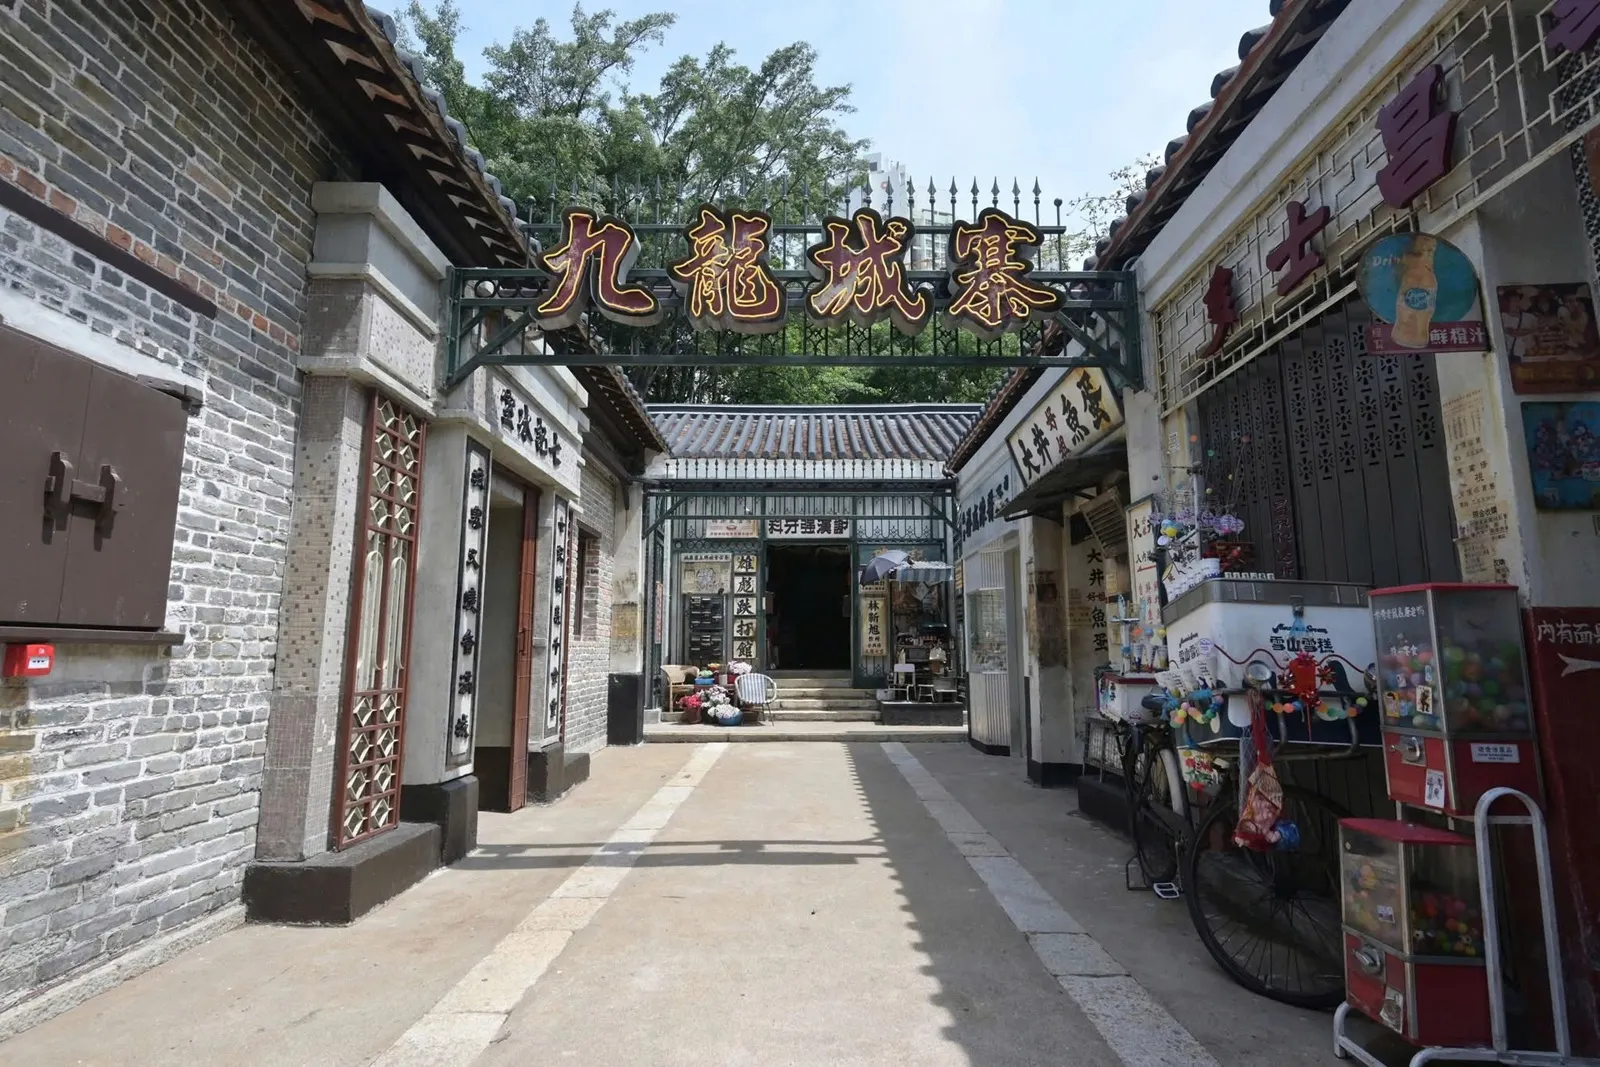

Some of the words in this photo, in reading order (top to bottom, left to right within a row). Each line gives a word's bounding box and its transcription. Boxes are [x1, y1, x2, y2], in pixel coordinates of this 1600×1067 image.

[536, 208, 1060, 330] 九龍城寨
[1430, 327, 1484, 345] 鮮橙汁
[737, 555, 755, 658] 雄彪跌打館
[1270, 635, 1335, 653] 雪山雪糕
